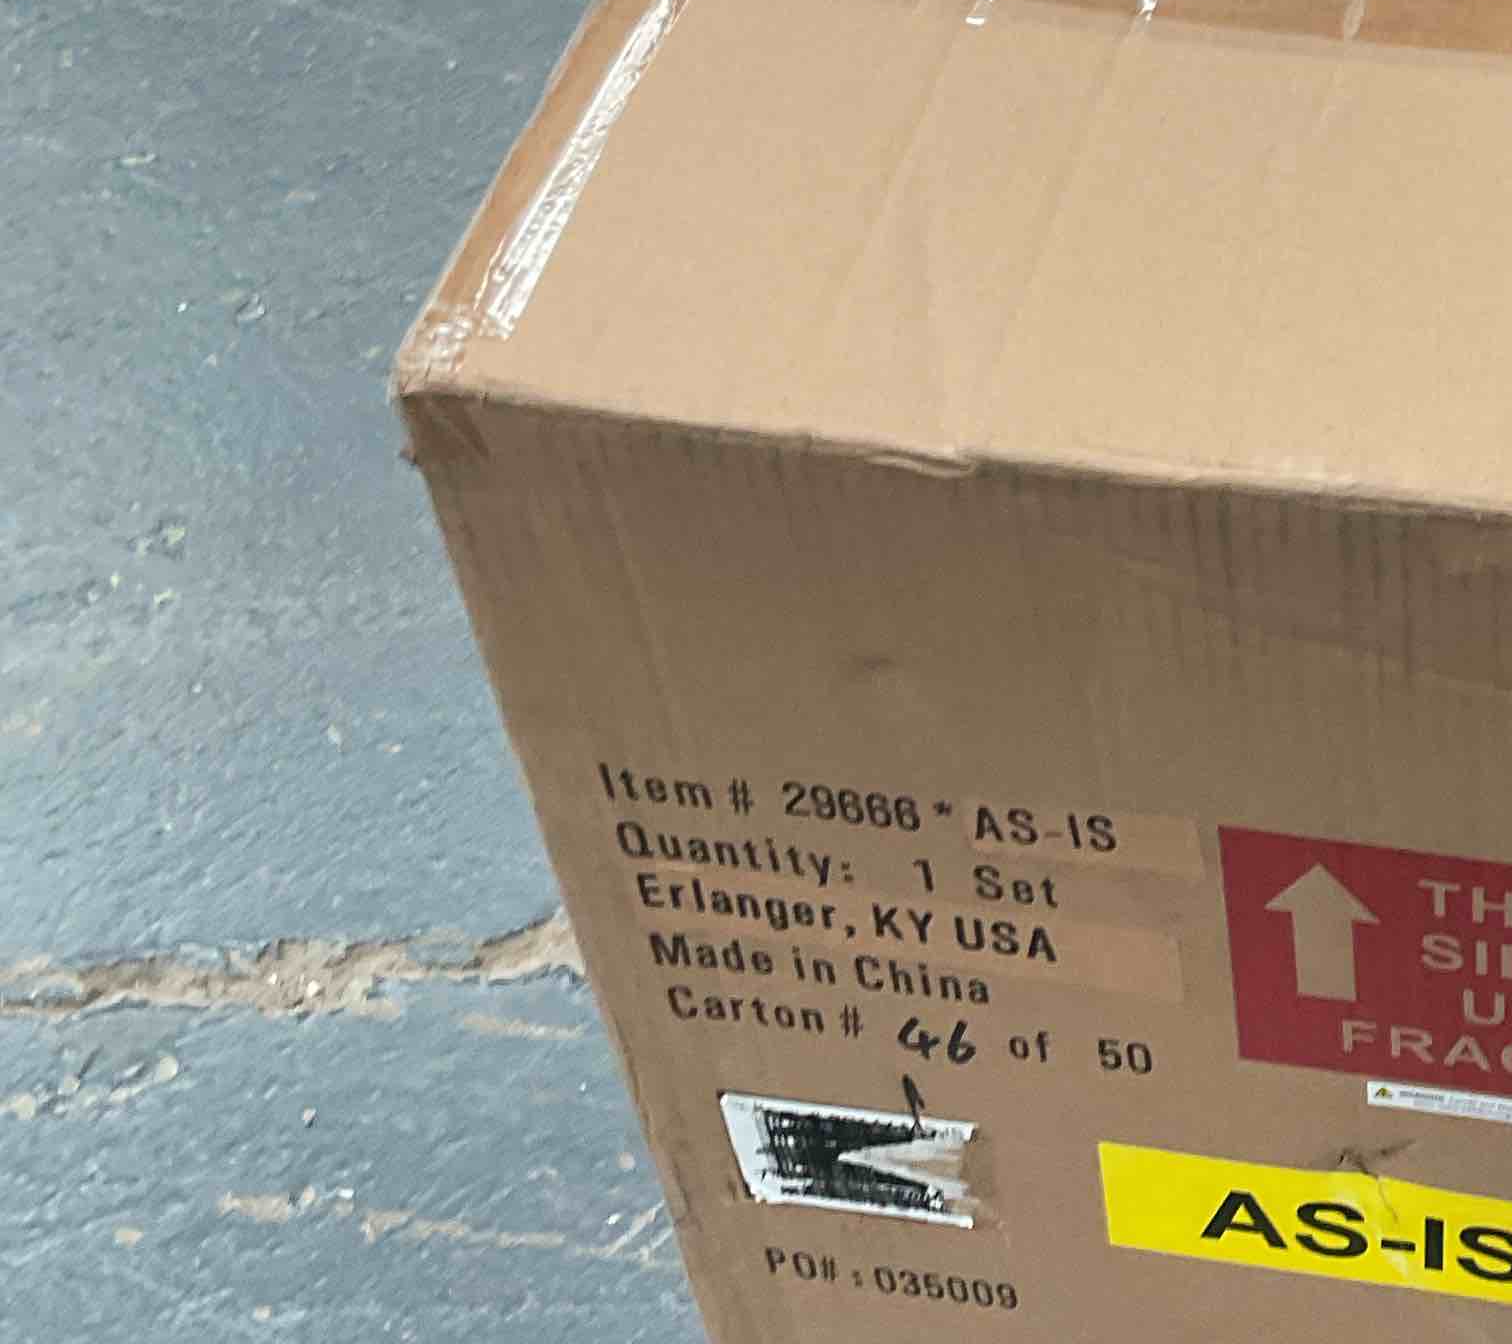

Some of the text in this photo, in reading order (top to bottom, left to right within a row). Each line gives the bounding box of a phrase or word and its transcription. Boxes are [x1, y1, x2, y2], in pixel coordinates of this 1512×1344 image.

[616, 820, 1058, 908] Quantity: 1 Set
[975, 805, 1117, 852] AS-IS
[650, 930, 990, 1004] Made in China
[954, 915, 1057, 962] USA
[667, 985, 824, 1035] Carton
[897, 1016, 977, 1064] 46
[1008, 1030, 1051, 1063] of
[1098, 1038, 1153, 1075] 50
